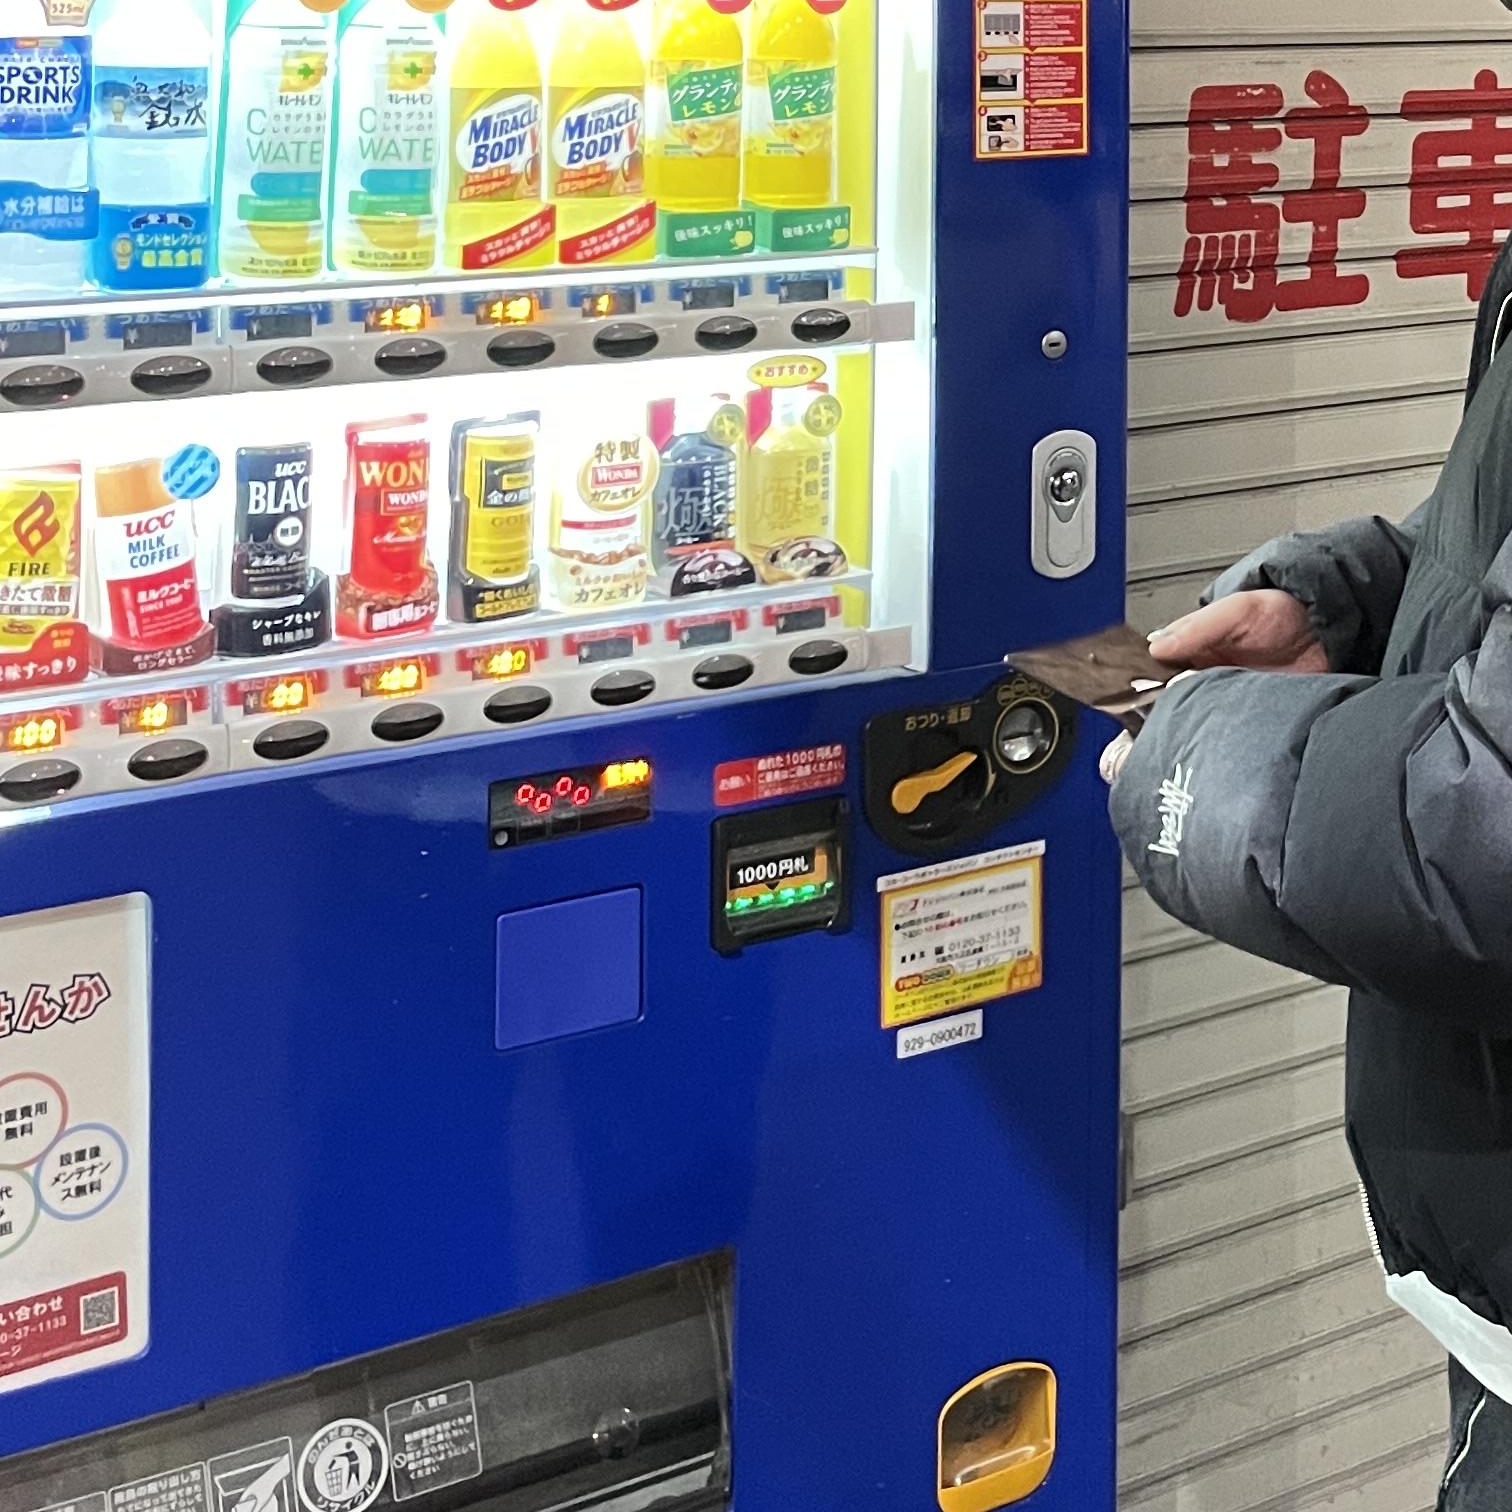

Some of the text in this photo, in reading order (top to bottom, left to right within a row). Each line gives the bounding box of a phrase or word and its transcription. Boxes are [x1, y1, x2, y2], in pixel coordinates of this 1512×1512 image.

[0, 84, 75, 106] DRINK
[468, 102, 540, 146] MIRACLE
[562, 102, 638, 144] MIRACLE
[472, 131, 527, 168] BODY
[567, 130, 623, 166] BODY
[274, 460, 307, 478] UCC
[359, 460, 429, 487] WON
[590, 486, 643, 505] カフェオレ
[123, 509, 176, 538] UCC
[128, 533, 166, 555] MILK
[129, 543, 180, 569] COFFEE
[8, 561, 51, 578] FIRE
[574, 582, 645, 605] カフェオレ
[736, 854, 810, 885] 1000円札
[903, 1022, 977, 1053] 929-0900472
[0, 1100, 48, 1126] 置費用
[50, 1160, 112, 1188] メンテナン
